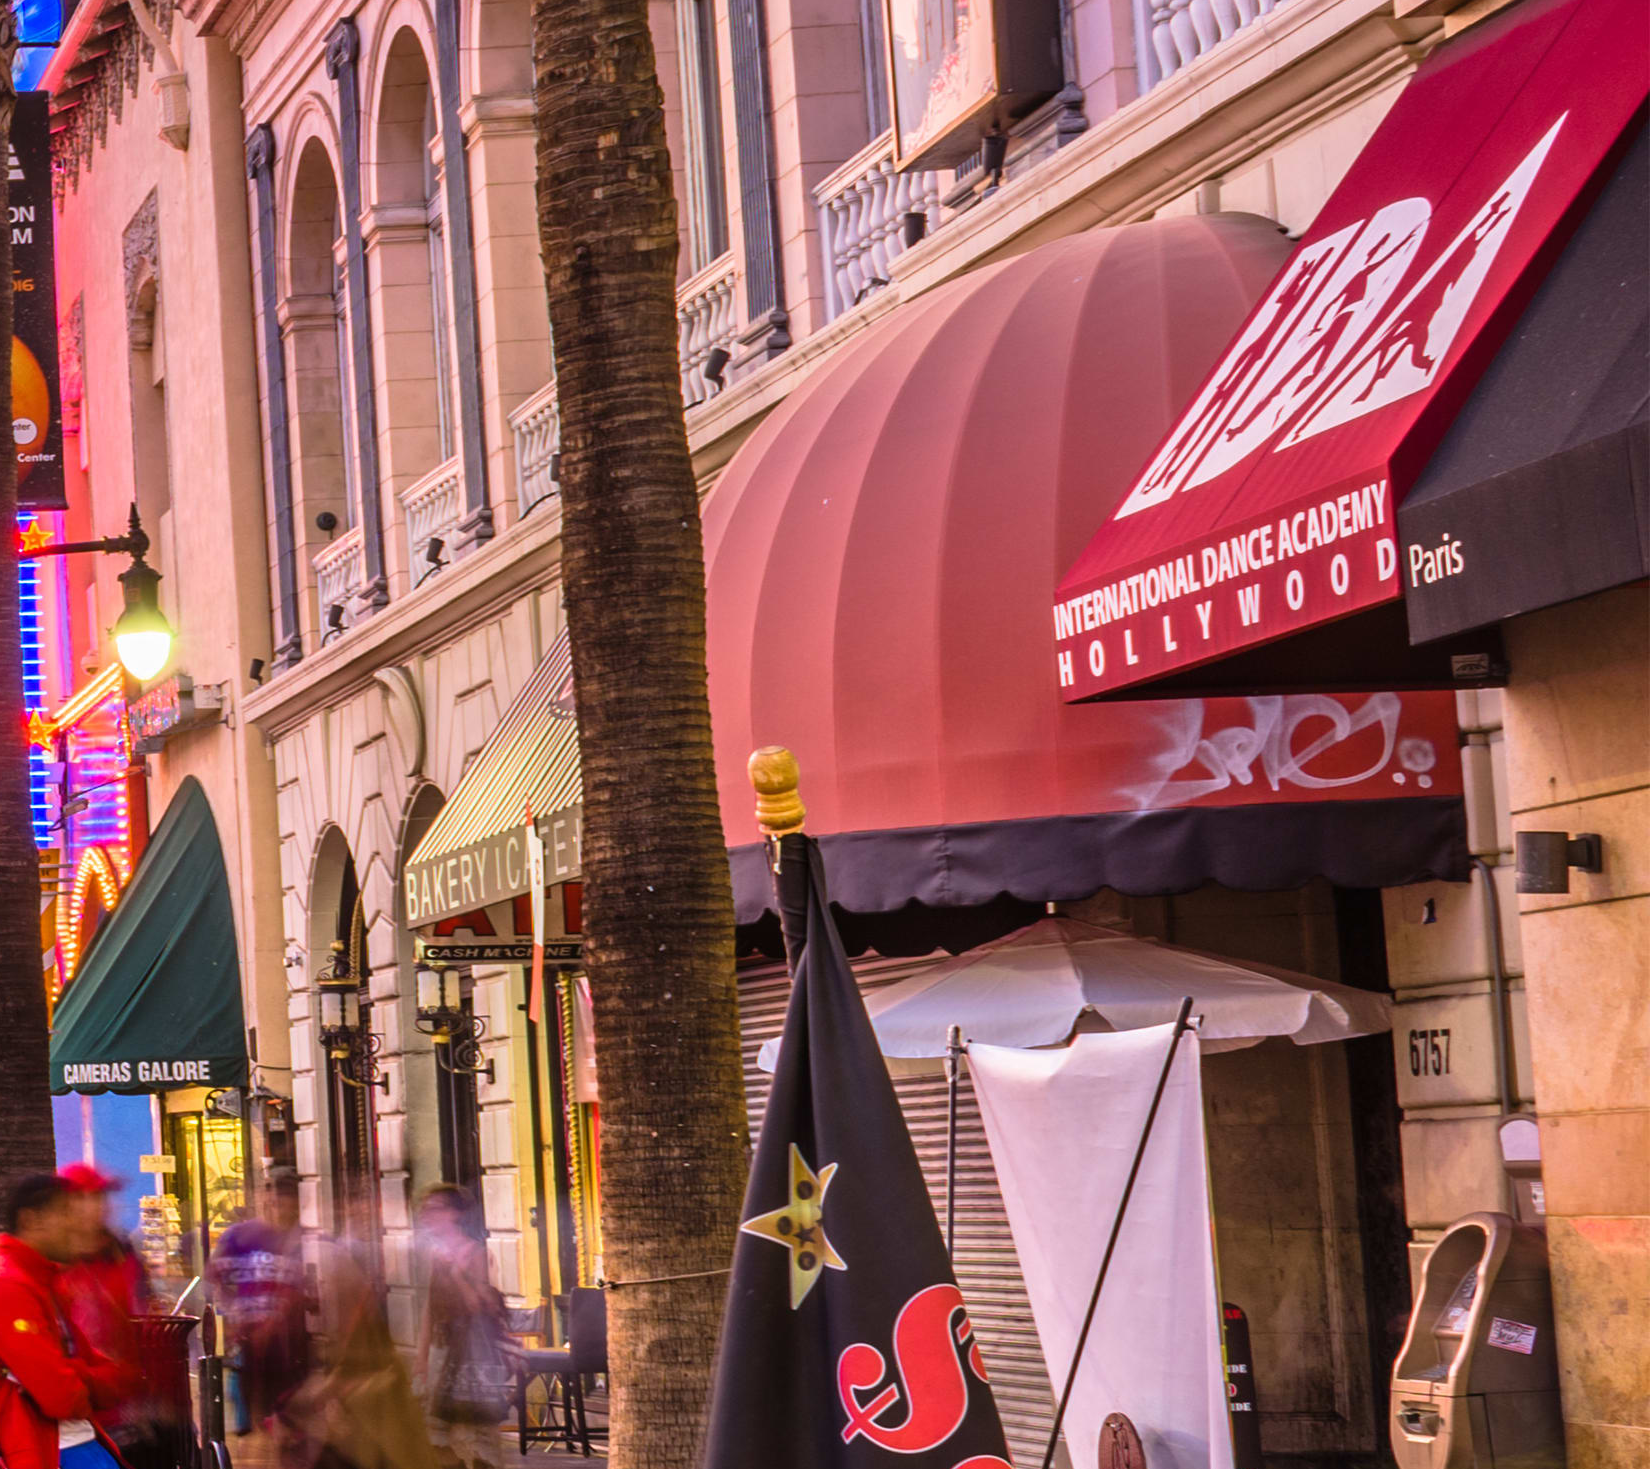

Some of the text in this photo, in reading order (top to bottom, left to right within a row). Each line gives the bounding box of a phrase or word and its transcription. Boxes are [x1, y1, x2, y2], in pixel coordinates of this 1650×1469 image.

[17, 452, 56, 464] Center
[1053, 479, 1388, 640] INTERNATIONAL DANCE ACADEMY
[1407, 533, 1464, 587] Paris
[1057, 537, 1397, 687] HOLLYWOOD
[406, 846, 488, 921] BAKERY
[426, 946, 480, 958] CASH
[63, 1060, 211, 1084] CAMERAS GALORE
[1409, 1029, 1452, 1078] 6757
